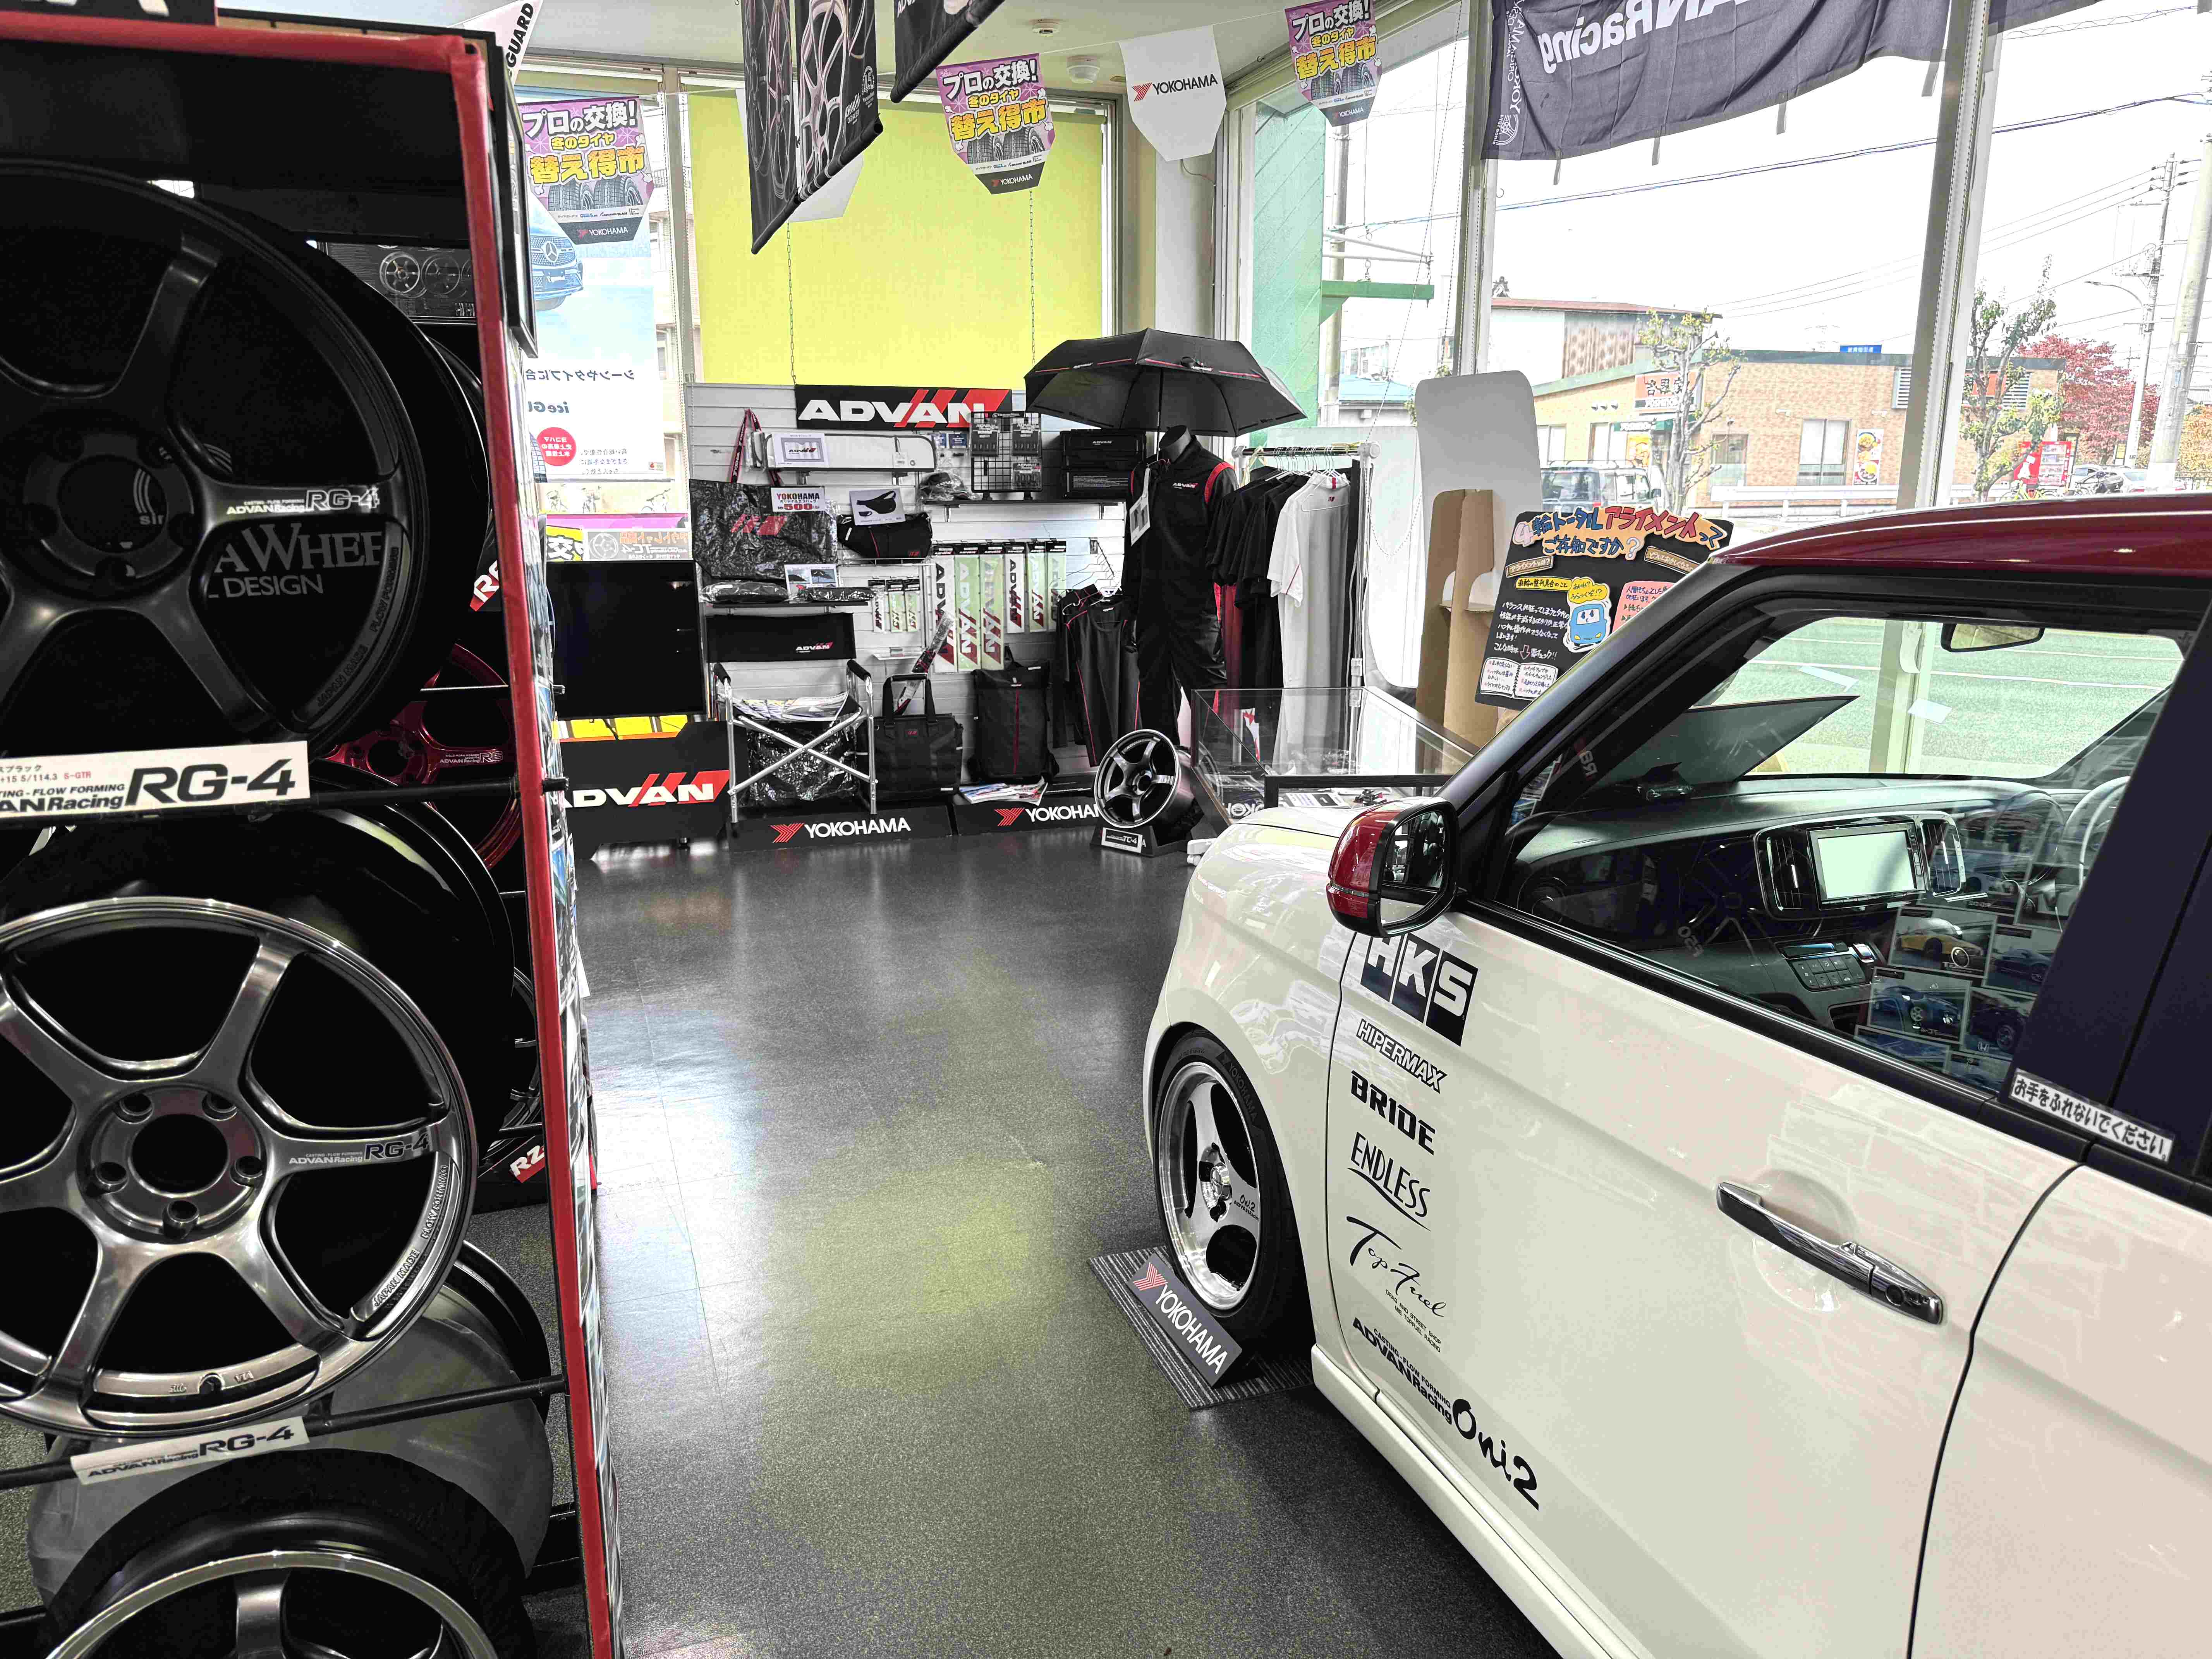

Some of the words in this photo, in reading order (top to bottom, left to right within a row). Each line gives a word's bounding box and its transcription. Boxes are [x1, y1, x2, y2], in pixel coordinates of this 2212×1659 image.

[1296, 36, 1376, 80] 替え得市
[943, 58, 1038, 100] プロの交換!
[1152, 74, 1218, 95] YOKOHAMA
[969, 89, 1020, 108] 冬のタイヤ
[1339, 106, 1364, 117] YOKOHAMA
[522, 99, 637, 139] プロの交換!
[950, 98, 1046, 141] 替え得市
[551, 132, 615, 151] 冬のタイヤ
[530, 146, 645, 184] 替え得市
[1000, 174, 1032, 185] YOKOHAMA
[589, 226, 628, 236] YOKOHAMA
[798, 399, 985, 424] ADVAN
[306, 486, 380, 511] RG-4
[223, 574, 324, 598] DESIGN
[1009, 559, 1018, 621] ADVAN
[21, 774, 58, 783] 5/114.3
[64, 771, 92, 780] S-GTR
[70, 783, 125, 794] FORMING
[125, 758, 296, 806] RG-4
[804, 817, 911, 839] YOKOHAMA
[1367, 935, 1473, 1017] HKS
[1356, 1018, 1448, 1094] HIPERMAX
[1351, 1070, 1436, 1156] BRIDE
[2014, 1079, 2166, 1161] お手をふれないでください。
[364, 1133, 429, 1161] RG-4
[1350, 1131, 1431, 1219] ENDLESS
[397, 1248, 421, 1279] MADE
[1346, 1216, 1402, 1269] Top
[1390, 1262, 1446, 1317] Fuel
[373, 1278, 400, 1307] JAPAN
[1155, 1285, 1228, 1374] YOKOHAMA
[1386, 1289, 1397, 1304] DRAG
[1399, 1303, 1408, 1314] AND
[1410, 1313, 1427, 1331] STREET
[1429, 1330, 1441, 1345] SHOP
[1424, 1334, 1441, 1353] RACING
[1421, 1375, 1451, 1409] FORMING
[199, 1425, 295, 1457] RG-4
[1452, 1398, 1539, 1511] Oni2
